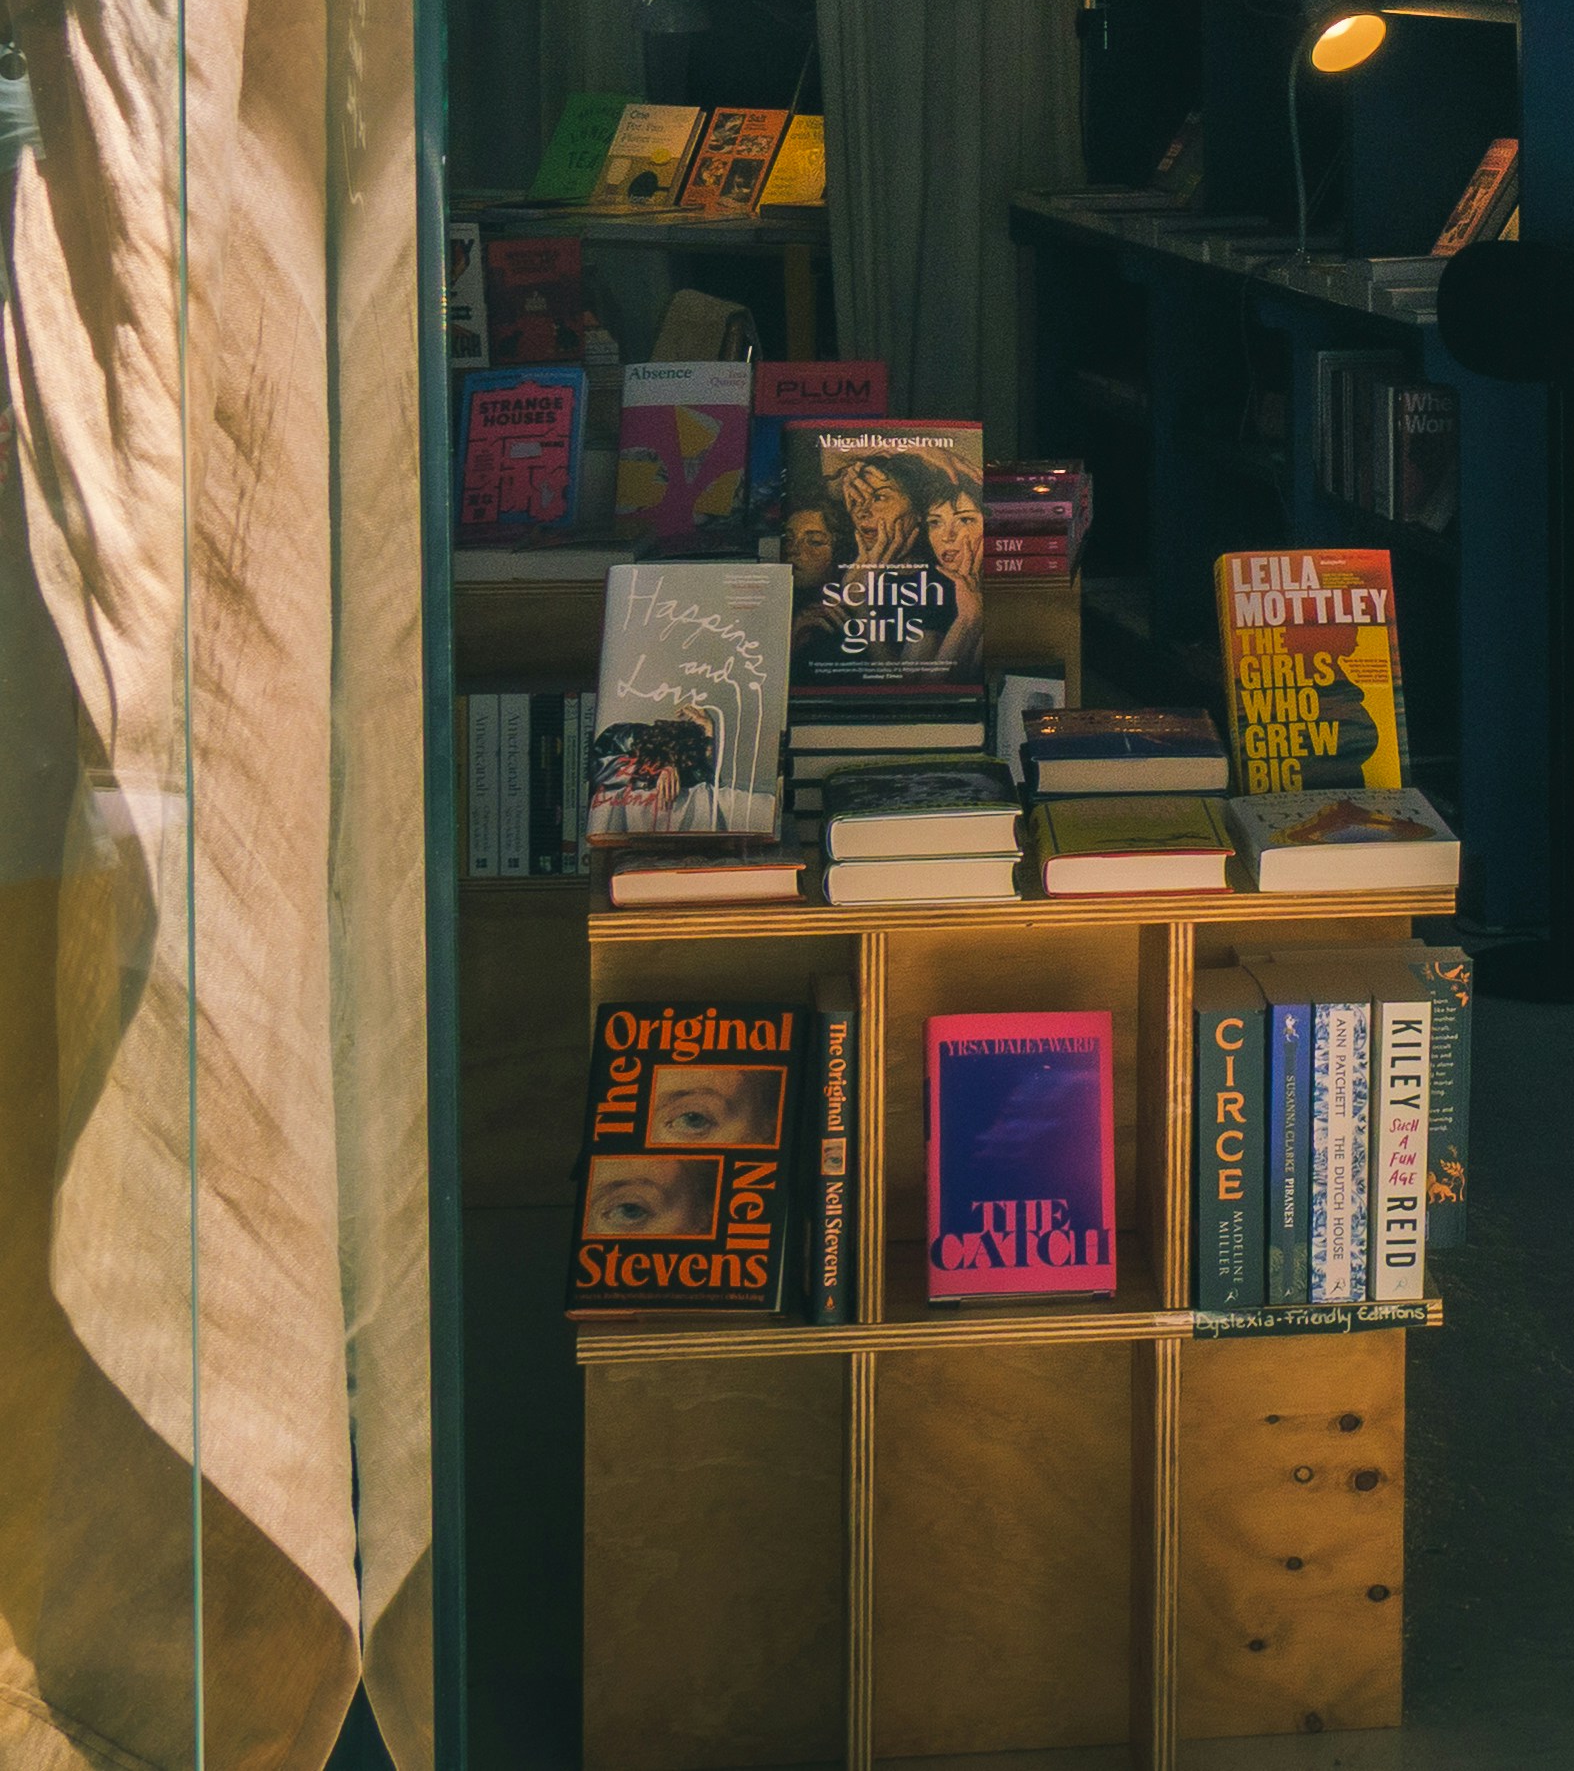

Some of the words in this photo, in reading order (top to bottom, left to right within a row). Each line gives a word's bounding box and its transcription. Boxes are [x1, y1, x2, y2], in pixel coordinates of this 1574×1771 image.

[628, 363, 694, 382] Absence
[776, 379, 871, 399] PLUM
[480, 396, 564, 415] STRANGE
[483, 410, 556, 427] HOUSES
[815, 433, 869, 453] Abigail
[869, 433, 954, 452] Bergstrom
[995, 540, 1024, 552] STAY
[995, 559, 1024, 572] STAY
[1231, 556, 1321, 593] LEILA
[822, 571, 944, 607] selfish
[1234, 588, 1388, 628] MOTTLEY
[841, 607, 925, 654] girls
[1236, 627, 1289, 654] THE
[617, 653, 709, 710] Love
[679, 655, 736, 684] and
[1239, 652, 1336, 690] GIRLS
[1240, 687, 1320, 724] WHO
[1245, 720, 1340, 759] GREW
[1248, 758, 1303, 795] BIG
[604, 1007, 795, 1063] Original
[828, 1020, 848, 1057] The
[947, 1038, 991, 1057] YRSA
[993, 1037, 1097, 1056] DALEY-WARD
[1335, 1017, 1348, 1049] ANN
[1388, 1017, 1423, 1111] KILEY
[594, 1055, 643, 1141] The
[822, 1058, 847, 1132] Original
[1286, 1074, 1297, 1131] SUSANNA
[1334, 1054, 1348, 1118] PATCHETT
[1214, 1017, 1248, 1202] CIRCE
[1284, 1131, 1296, 1176] CLARKE
[1333, 1136, 1346, 1163] THE
[1389, 1152, 1417, 1168] FUN
[1398, 1135, 1409, 1151] A
[1333, 1166, 1345, 1212] DUTCH
[1388, 1170, 1417, 1187] AGE
[726, 1160, 779, 1251] Nell
[825, 1182, 844, 1215] Nell
[971, 1197, 1071, 1231] THE
[1282, 1176, 1296, 1229] PIRANESI
[929, 1228, 1112, 1272] CATCH
[1217, 1220, 1231, 1278] MILLER
[1231, 1210, 1244, 1285] MADELINE
[1332, 1214, 1345, 1261] HOUSE
[1384, 1195, 1418, 1269] REID
[575, 1242, 770, 1288] Stevens
[822, 1216, 842, 1288] Stevens
[1194, 1307, 1352, 1339] Dyslexia-Friendly
[1356, 1303, 1427, 1322] Editions
